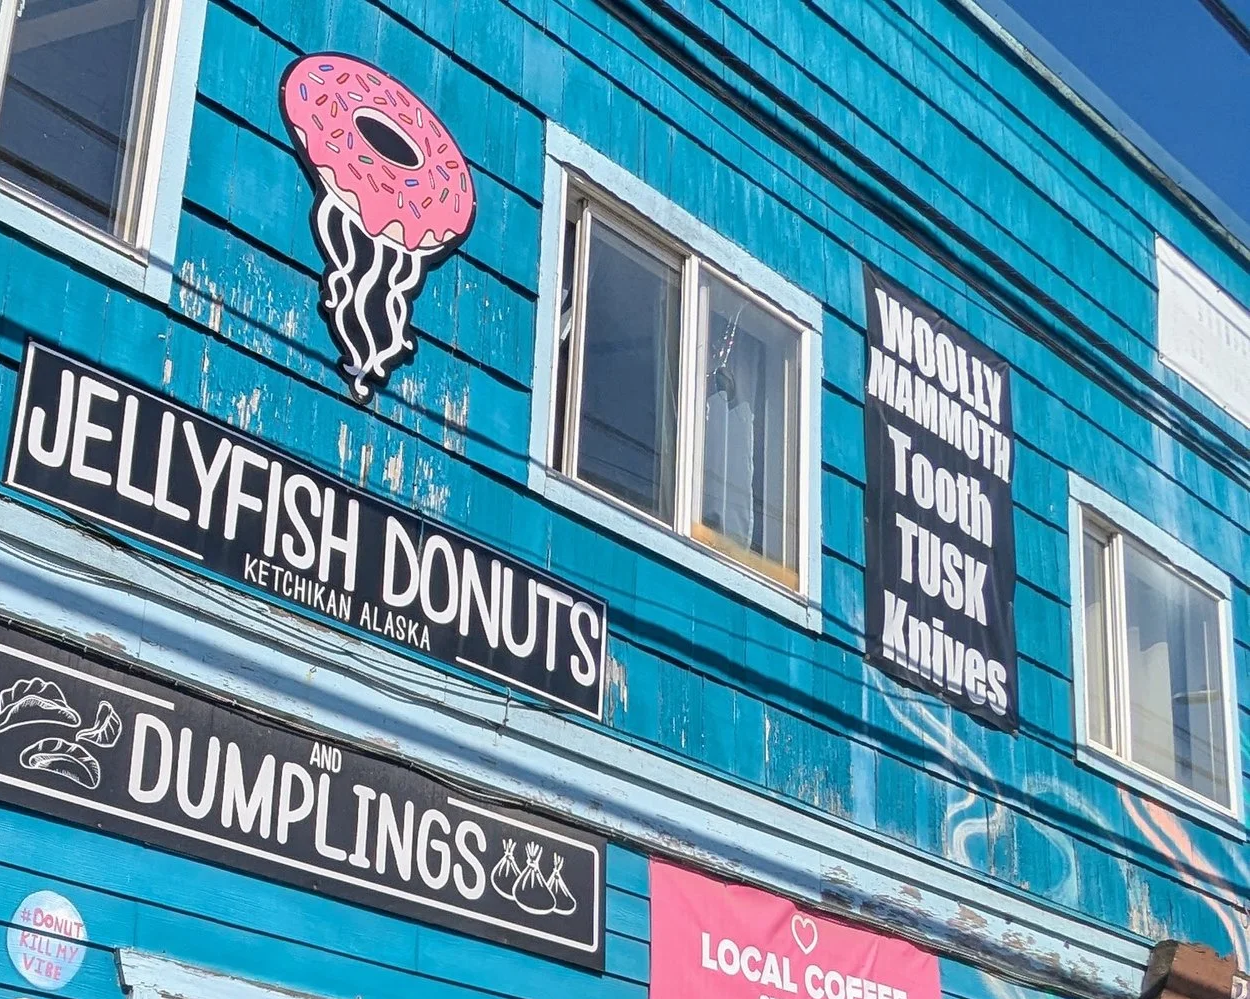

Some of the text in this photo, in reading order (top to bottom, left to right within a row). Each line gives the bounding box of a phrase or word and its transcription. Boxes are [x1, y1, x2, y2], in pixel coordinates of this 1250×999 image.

[868, 345, 1010, 483] MAMMOTH
[874, 287, 1001, 425] WOOLLY
[27, 370, 599, 688] JELLYFISH DONUTS
[887, 424, 993, 548] Tooth
[244, 553, 431, 651] KETCHIKAN ALASKA
[896, 513, 988, 626] TUSK
[882, 589, 1007, 716] Knives
[128, 711, 487, 898] DUMPLINGS
[309, 741, 342, 772] AND
[19, 931, 79, 962] KILL MY
[22, 953, 62, 980] VIBE
[701, 931, 798, 994] LOCAL
